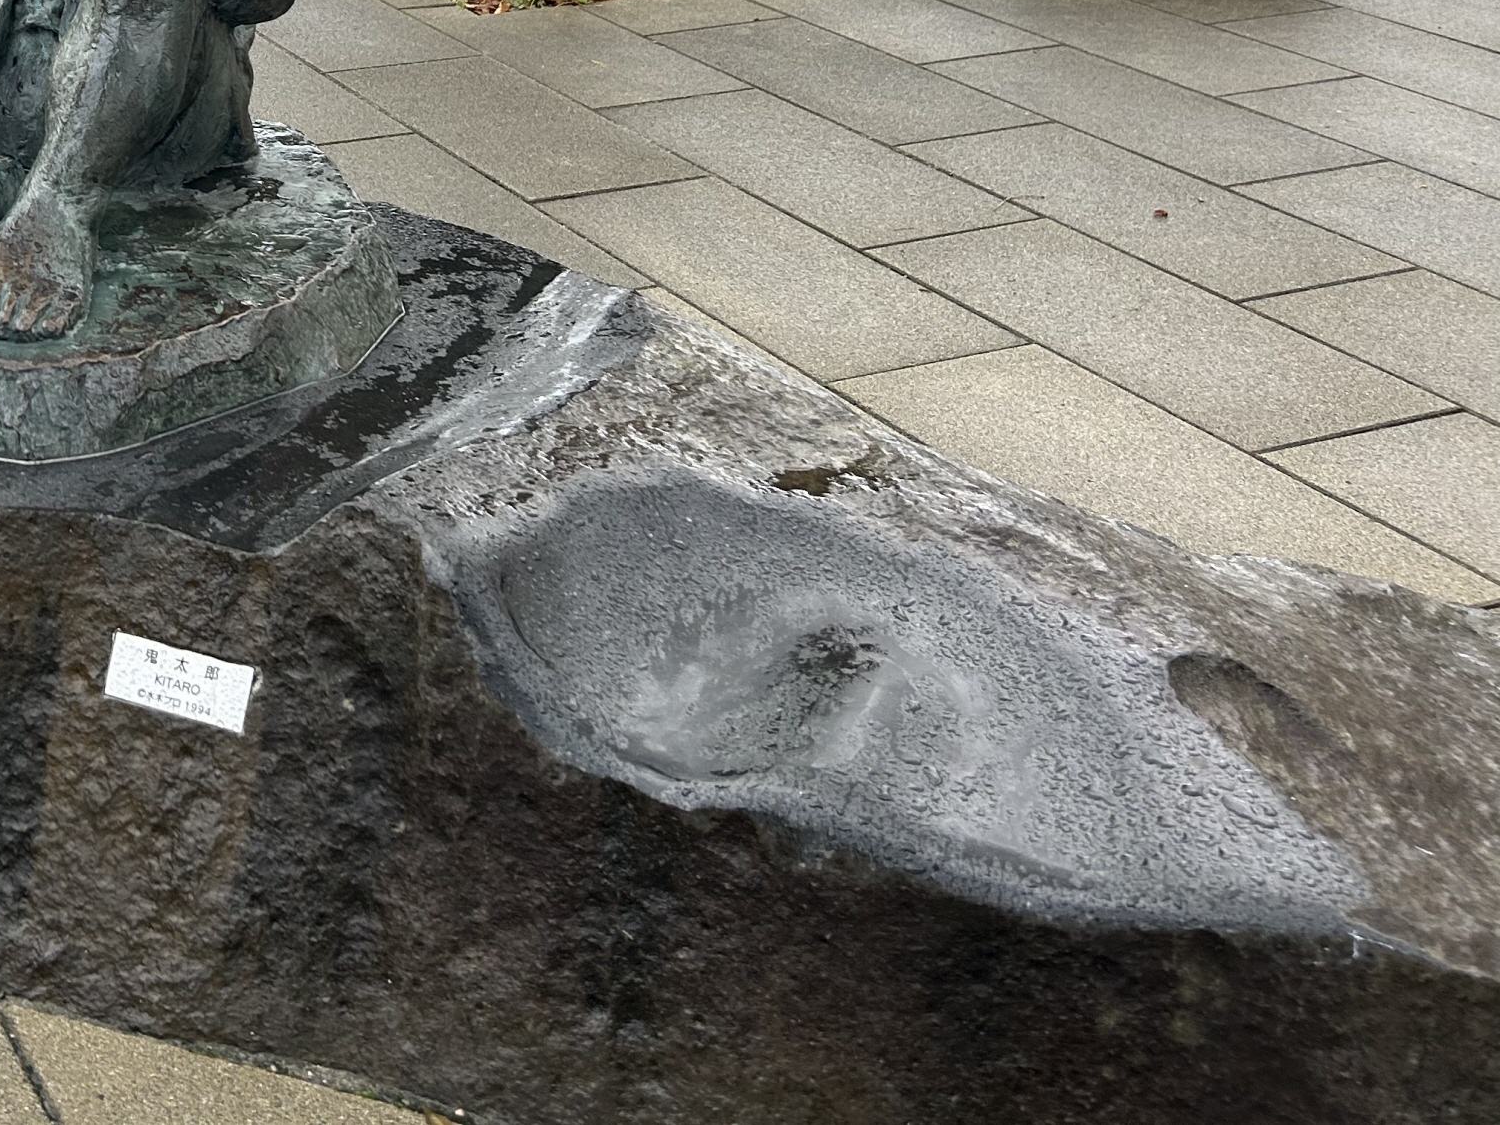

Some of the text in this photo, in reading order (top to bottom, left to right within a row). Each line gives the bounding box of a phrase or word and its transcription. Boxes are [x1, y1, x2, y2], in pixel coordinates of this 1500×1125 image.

[144, 648, 220, 681] 鬼太郎
[155, 674, 201, 696] KITARO
[185, 701, 211, 716] 1994
